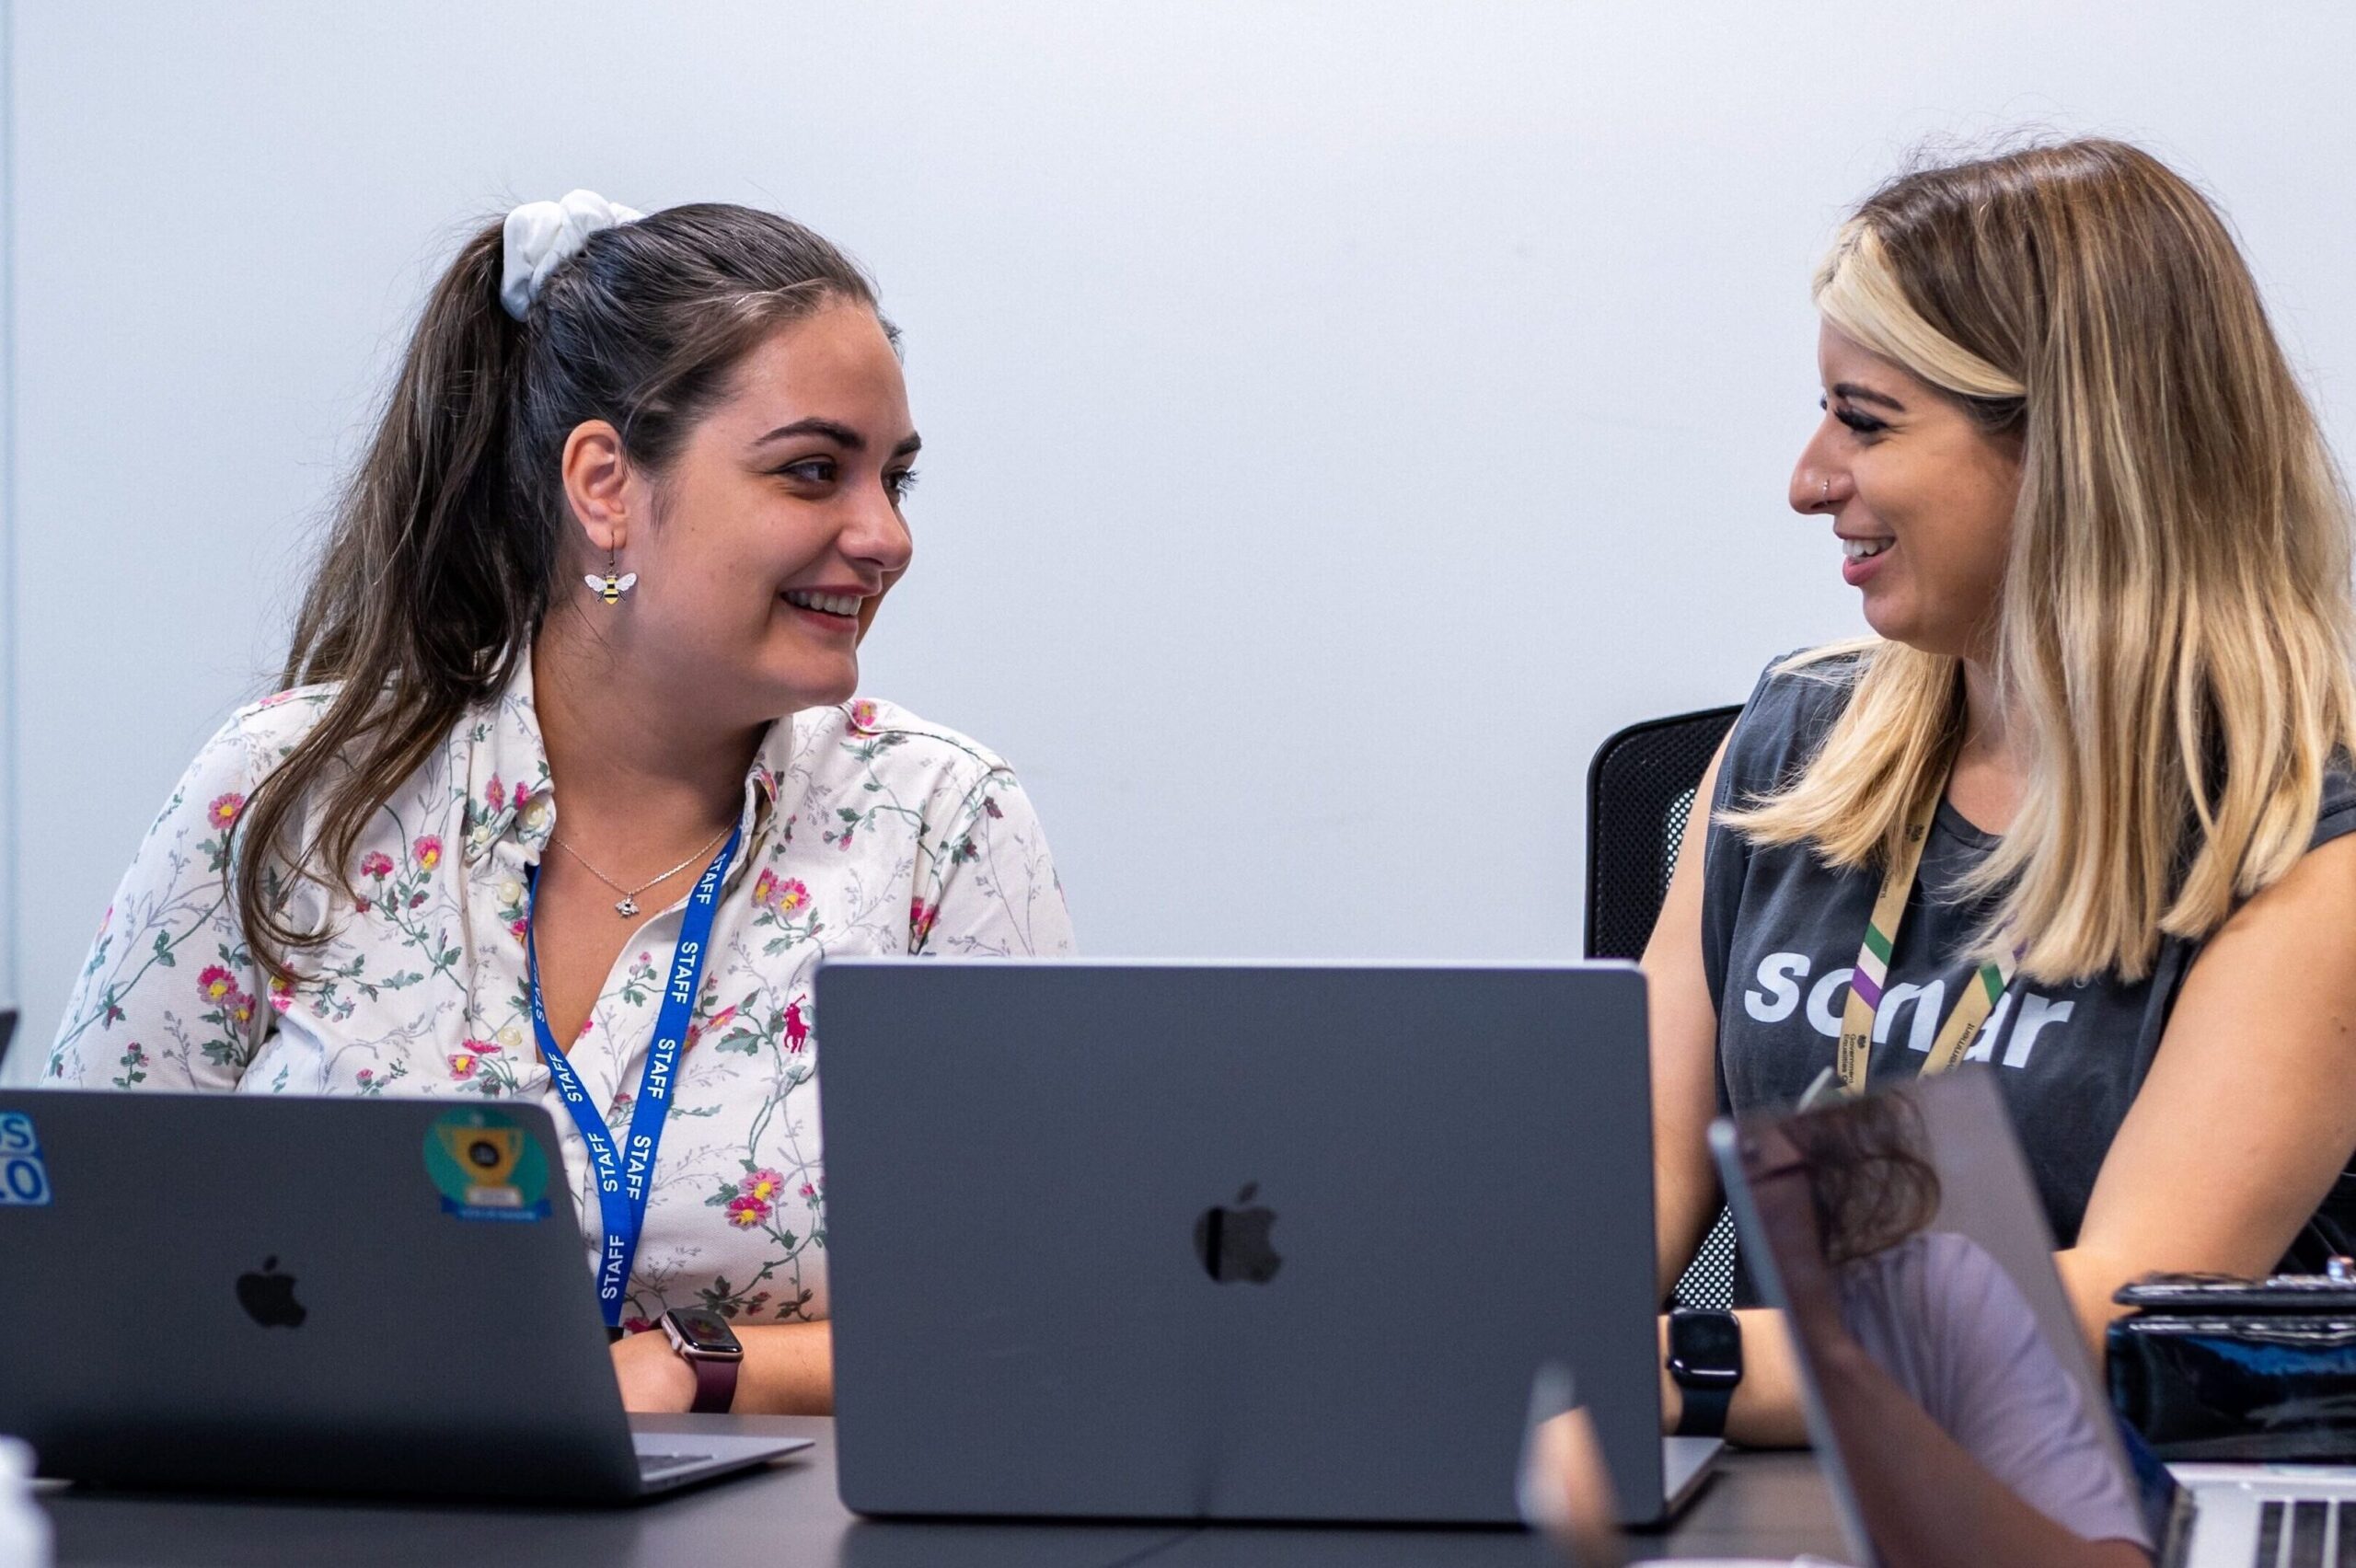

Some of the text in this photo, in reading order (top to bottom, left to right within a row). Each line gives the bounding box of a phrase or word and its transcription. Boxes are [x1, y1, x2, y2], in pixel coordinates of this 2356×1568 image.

[696, 853, 727, 905] STAFF
[671, 940, 699, 1005] STAFF
[548, 1053, 583, 1102] STAFF
[647, 1038, 676, 1100] STAFF
[588, 1133, 618, 1193] STAFF
[626, 1135, 652, 1201] STAFF
[601, 1235, 625, 1300] STAFF
